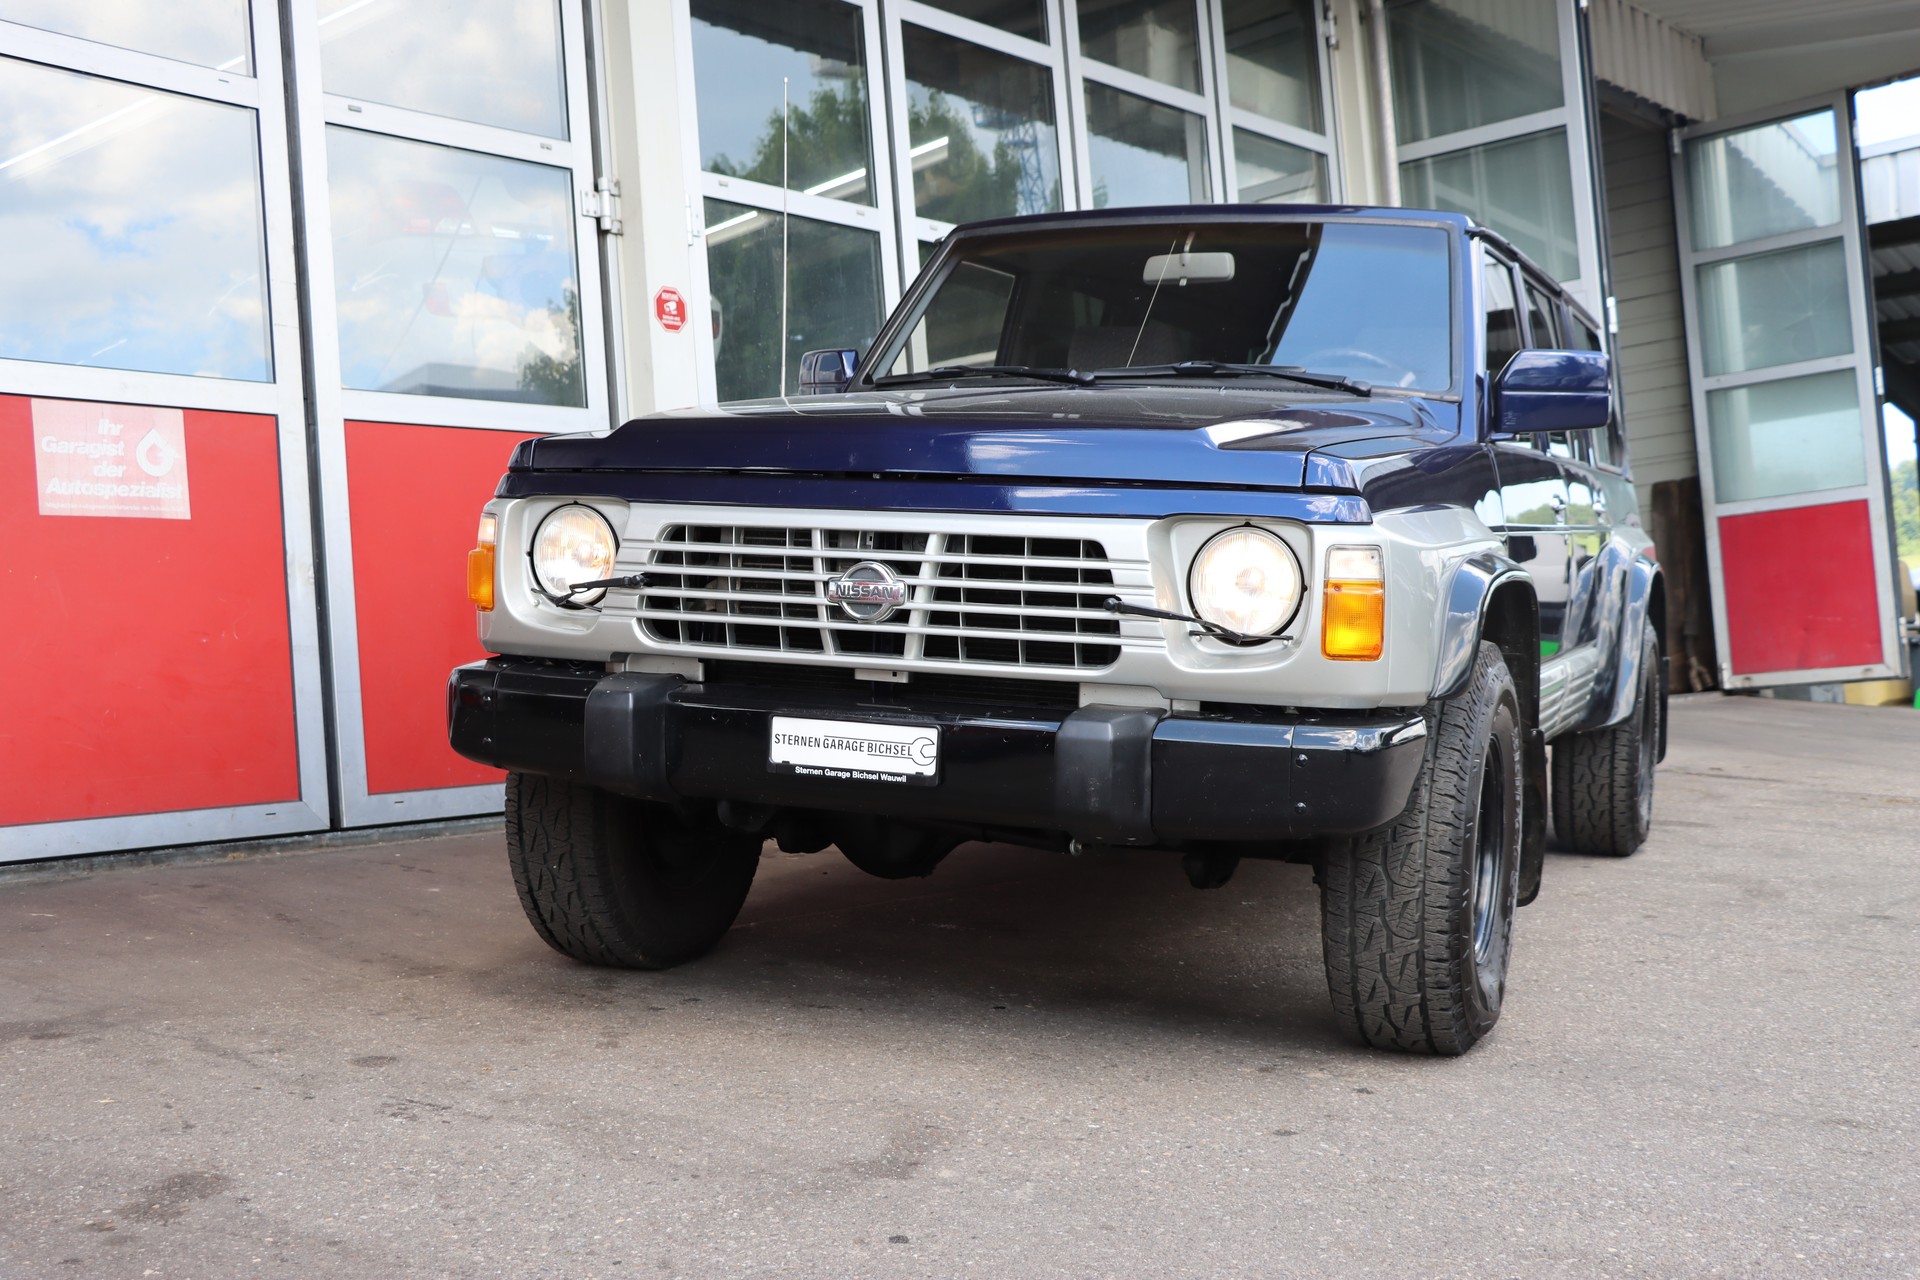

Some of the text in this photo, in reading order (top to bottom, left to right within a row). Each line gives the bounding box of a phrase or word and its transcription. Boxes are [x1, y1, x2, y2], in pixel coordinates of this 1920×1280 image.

[97, 418, 124, 436] Ihr
[41, 435, 125, 458] Garagist
[93, 460, 127, 477] der
[45, 477, 182, 499] Autospezialist
[836, 584, 893, 599] NISSAN
[774, 733, 913, 756] STERNEN GARAGE BICHSEL
[795, 766, 907, 783] Sternen Garage Bichsel Wauwil
